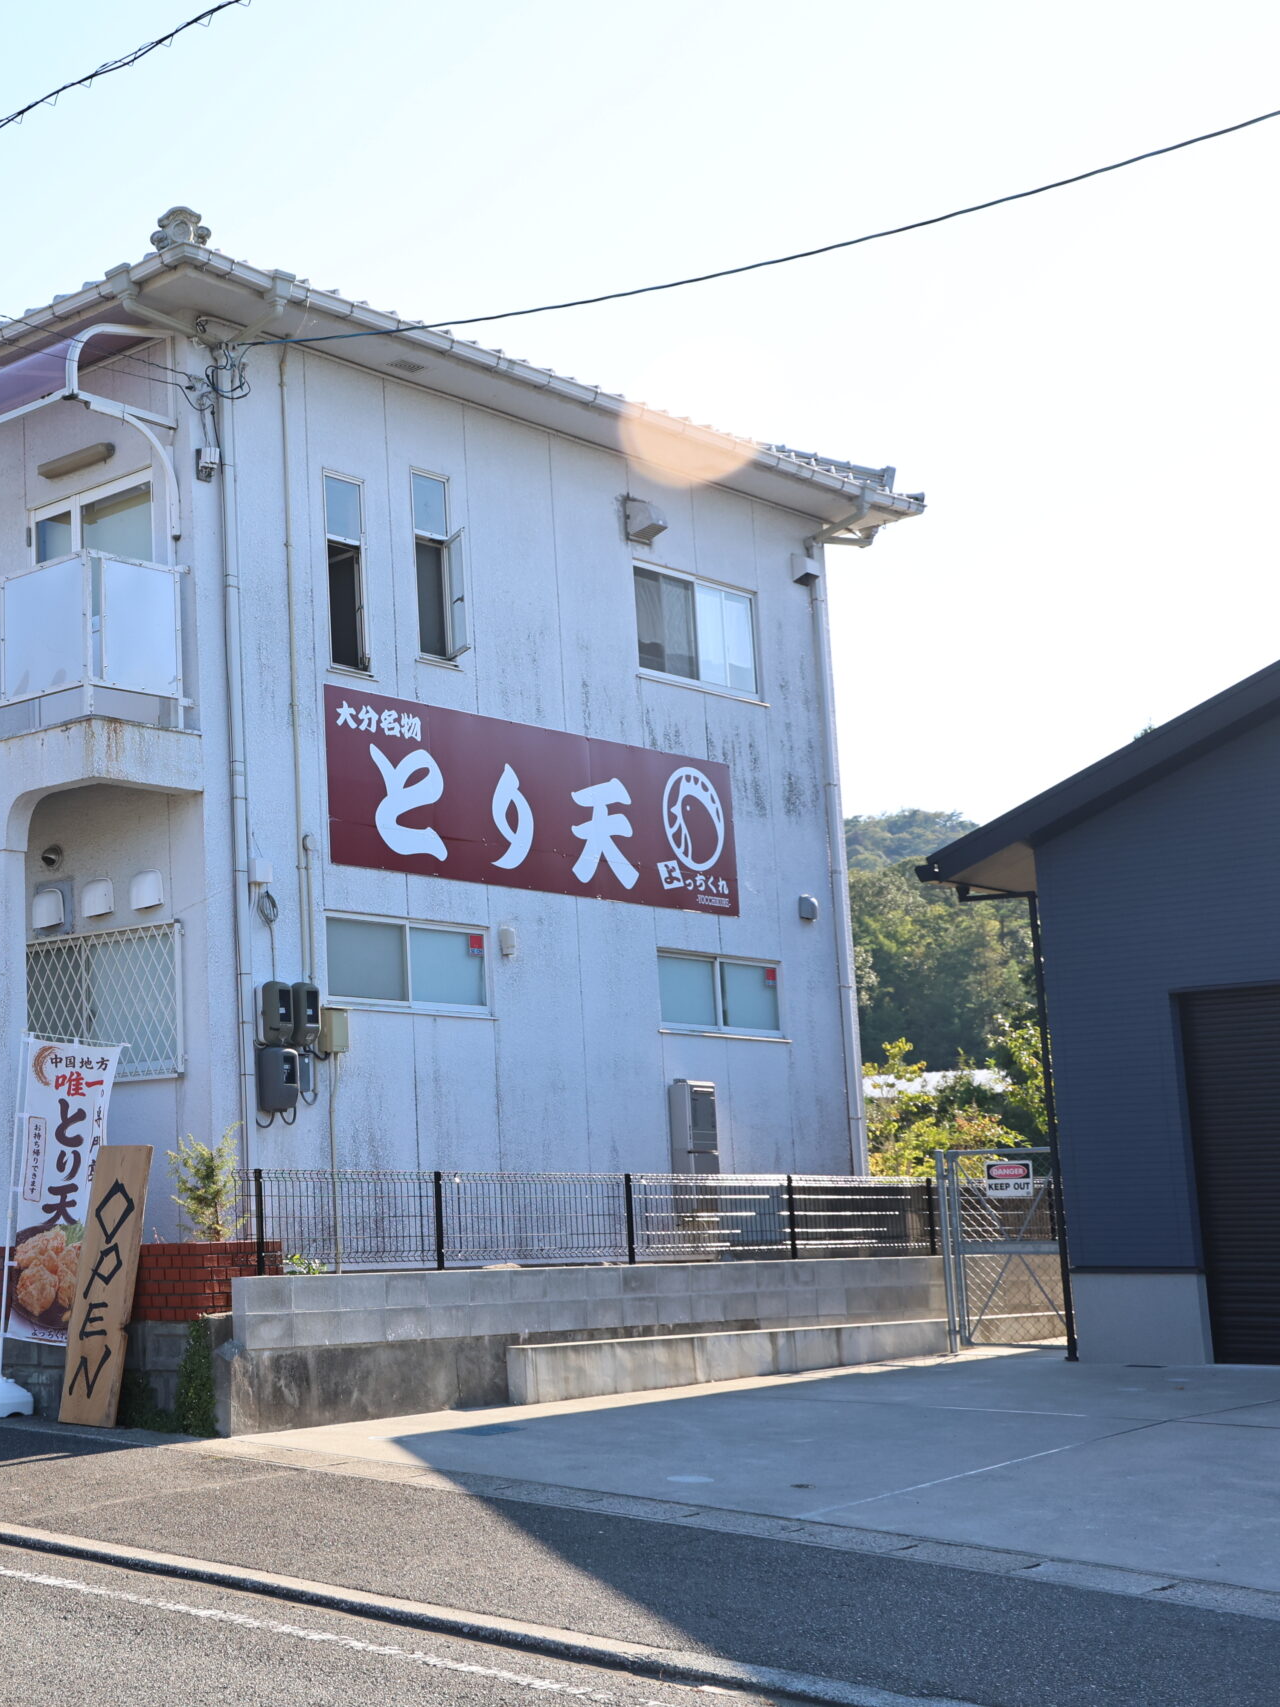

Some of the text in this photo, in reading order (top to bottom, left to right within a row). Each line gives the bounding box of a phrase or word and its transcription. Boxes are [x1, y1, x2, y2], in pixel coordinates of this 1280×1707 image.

[336, 700, 421, 742] 大分名物
[369, 743, 639, 890] とり天
[657, 860, 729, 894] よっちくれ
[49, 1054, 110, 1072] 中国地方
[54, 1071, 104, 1098] 唯一
[29, 1123, 42, 1195] お持ち帰りできます
[42, 1098, 87, 1226] とり天
[992, 1168, 1024, 1176] DANGER
[988, 1182, 1031, 1191] KEEP OUT
[68, 1178, 135, 1399] OPEN
